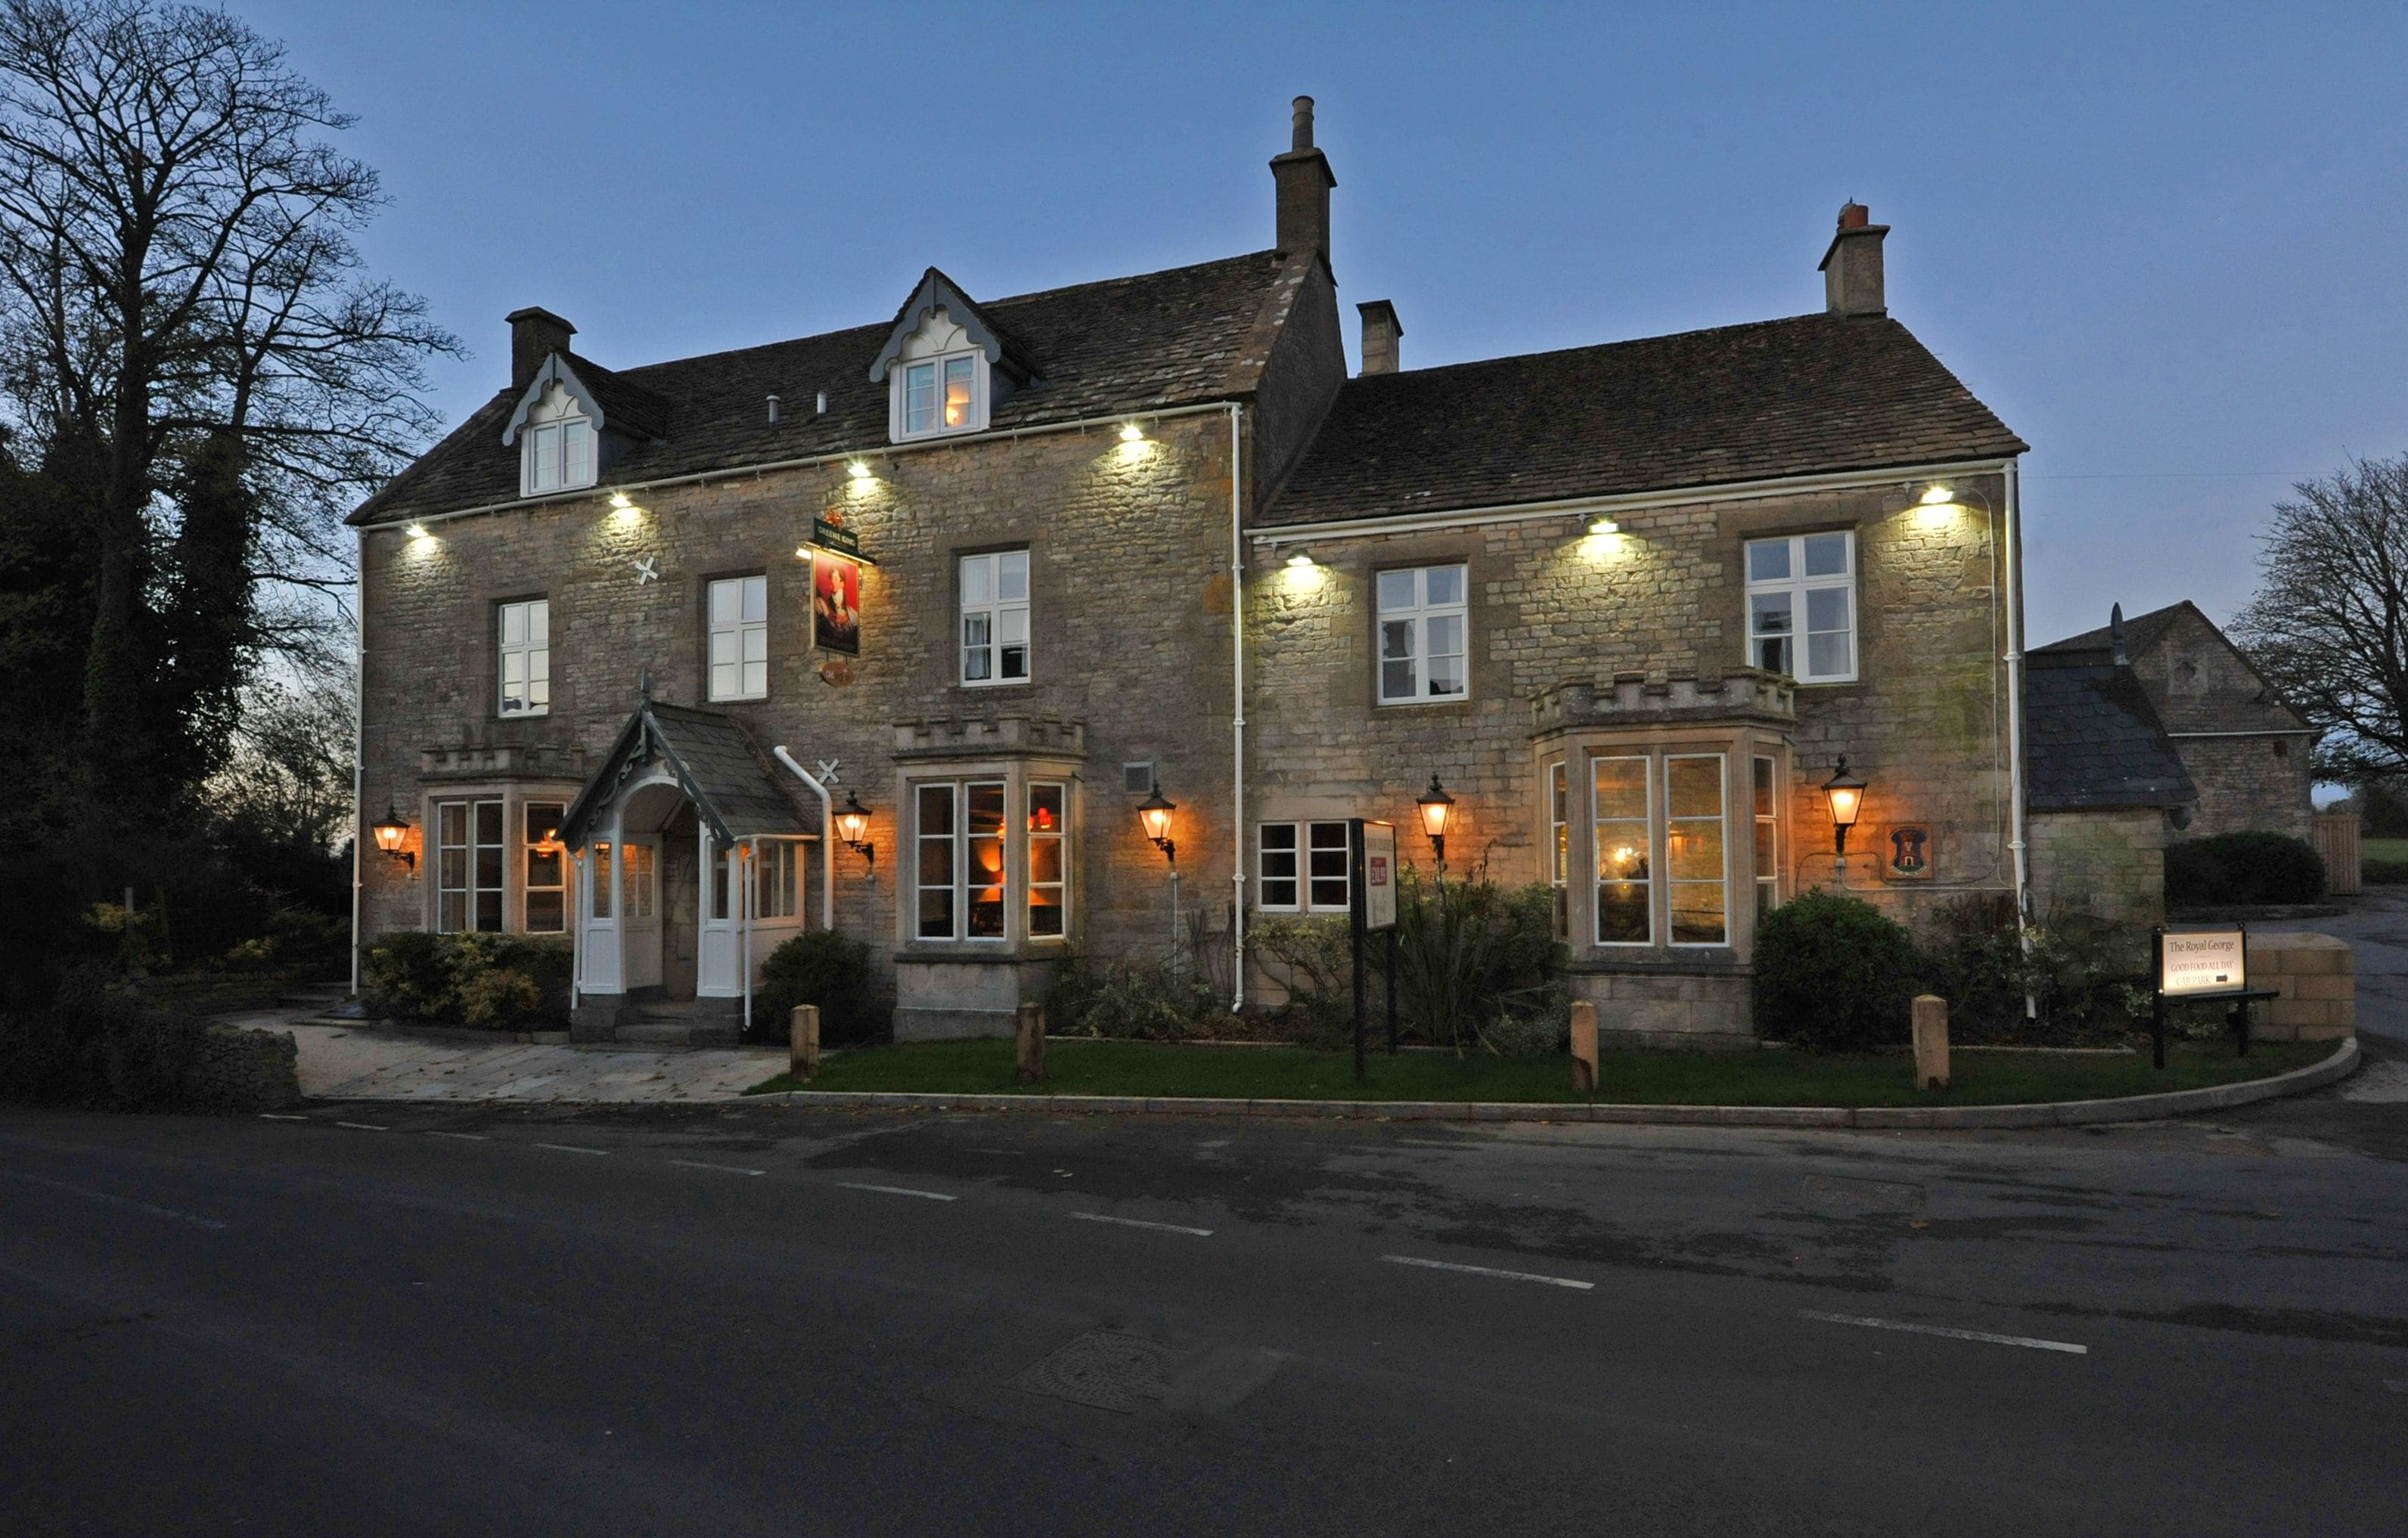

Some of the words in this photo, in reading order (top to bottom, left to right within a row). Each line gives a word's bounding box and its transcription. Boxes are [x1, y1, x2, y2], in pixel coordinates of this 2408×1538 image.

[818, 526, 840, 541] GREENE
[2170, 941, 2184, 952] The
[2186, 940, 2207, 953] Royal
[2208, 940, 2234, 951] George
[2171, 963, 2189, 972] GOOD
[2190, 962, 2208, 970] FOOD
[2208, 961, 2220, 969] ALL
[2221, 960, 2234, 969] DAY
[2177, 977, 2190, 986] CAR
[2192, 975, 2211, 985] PARK
